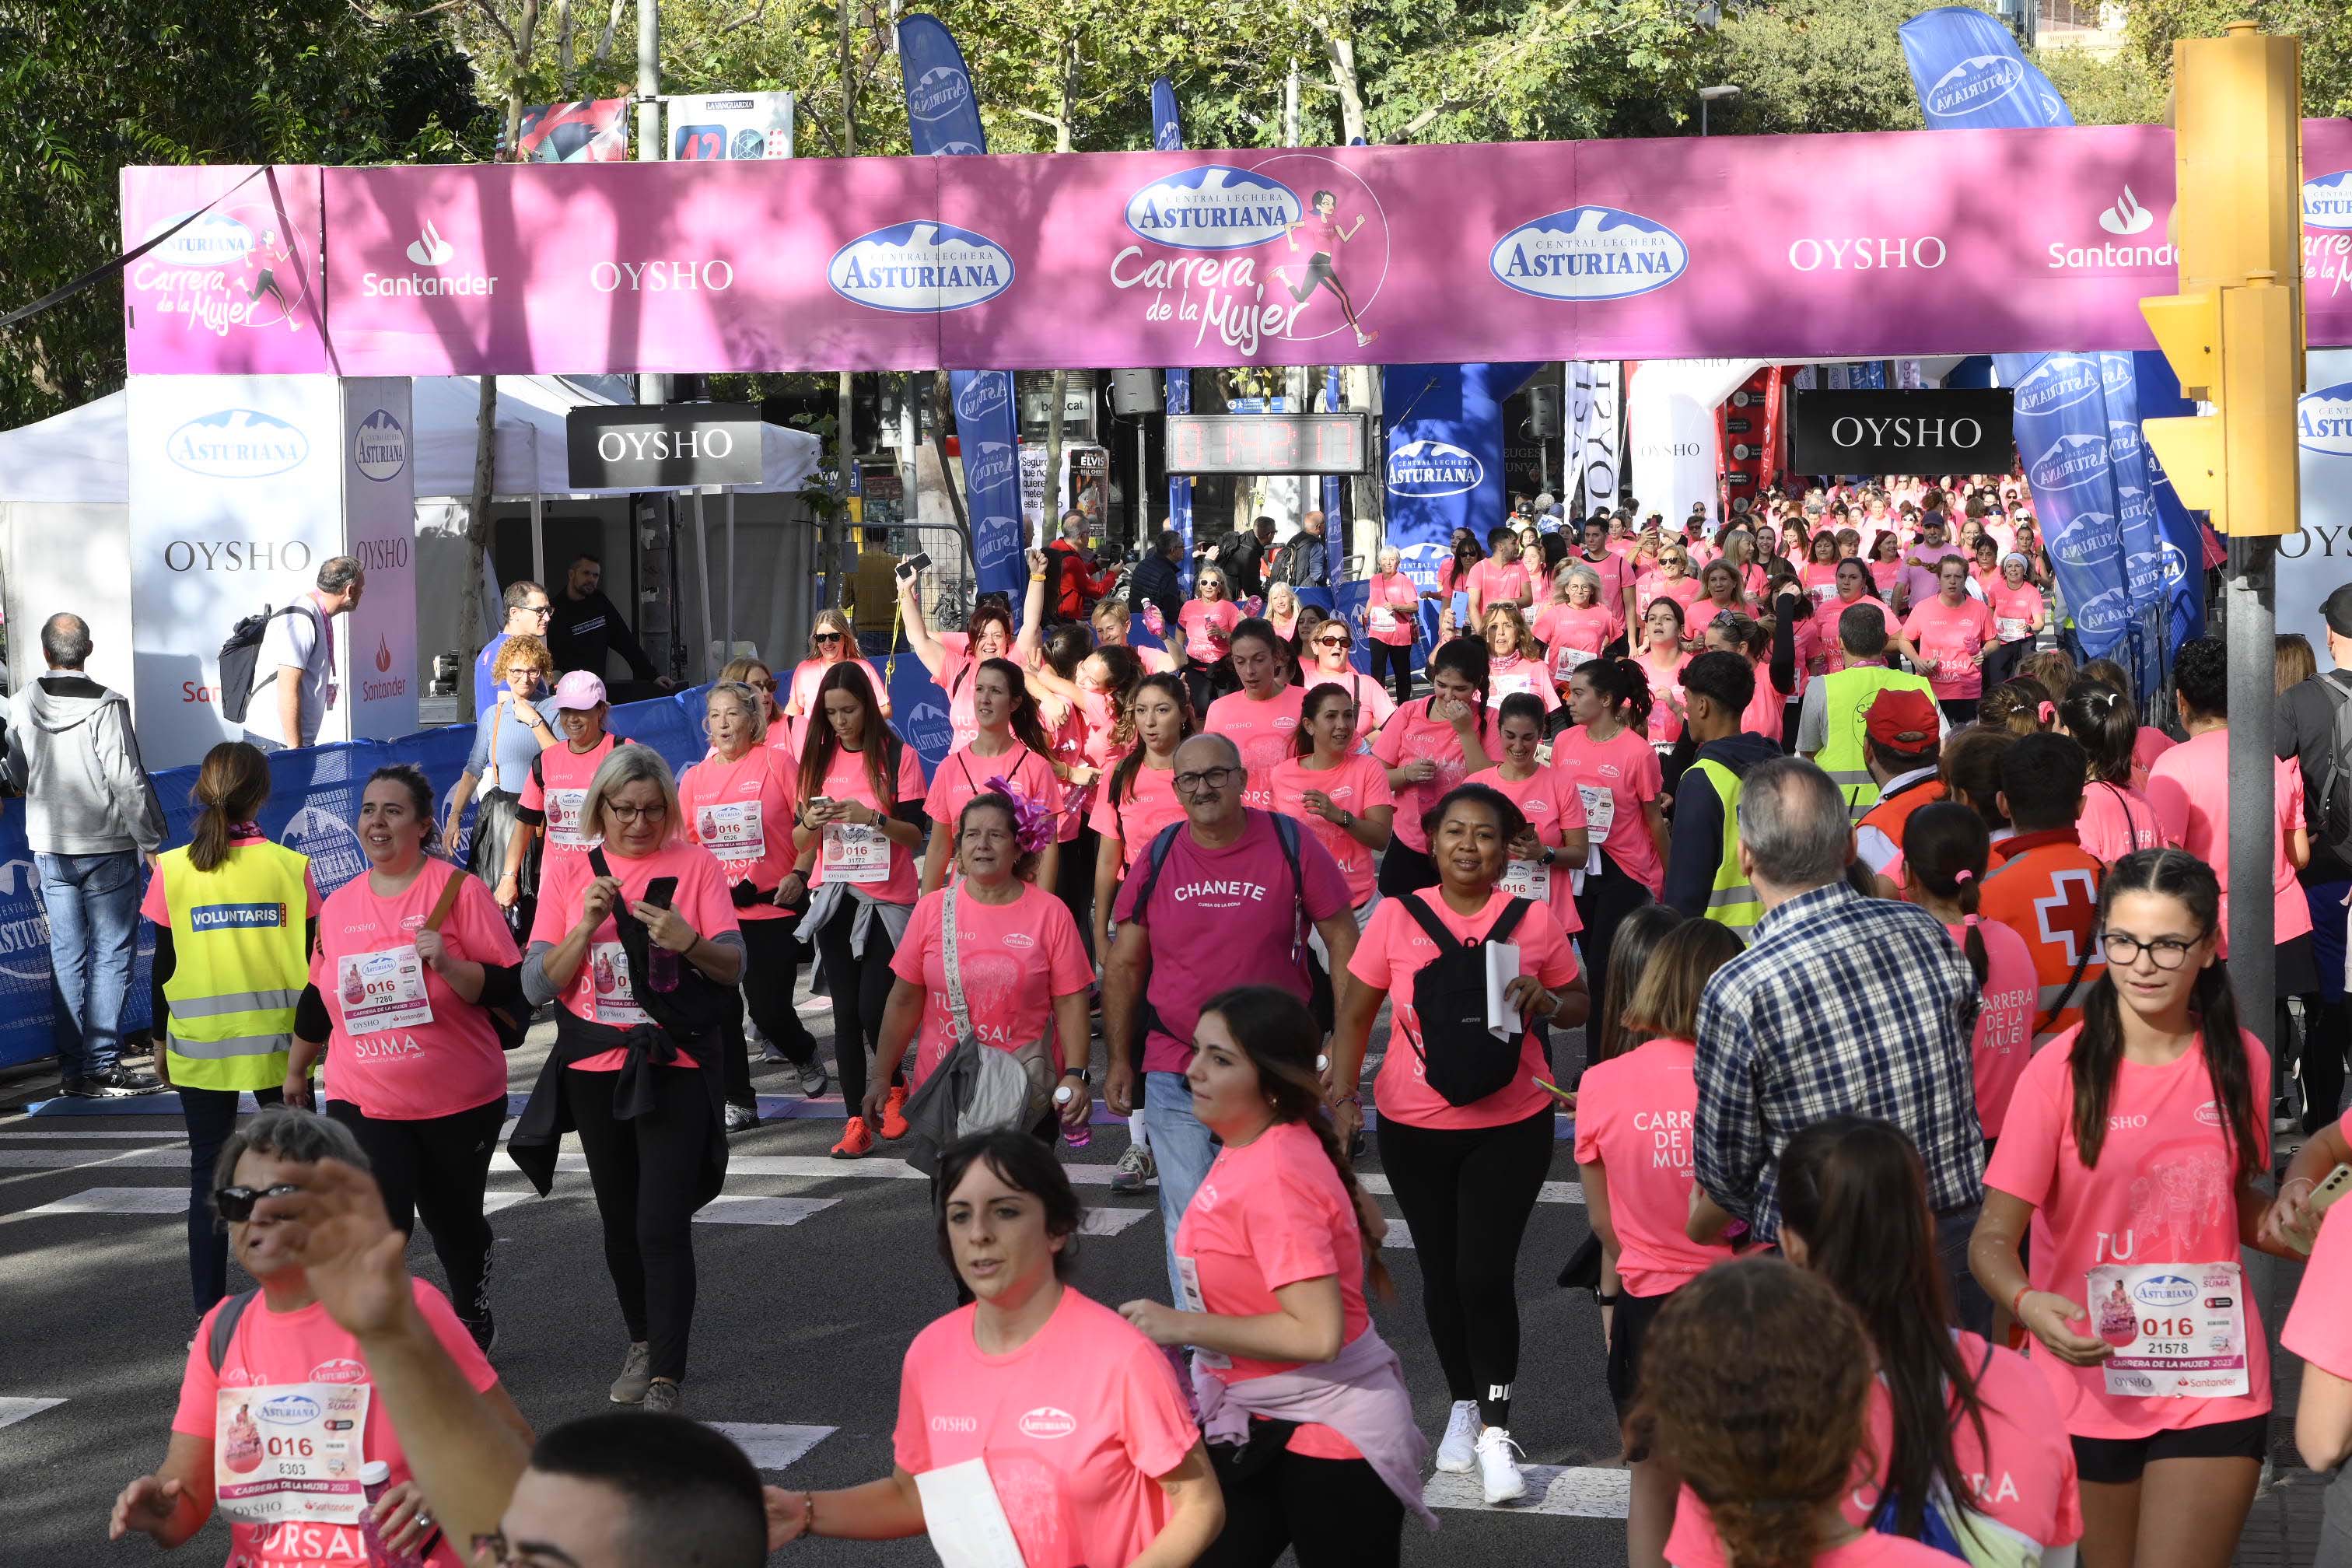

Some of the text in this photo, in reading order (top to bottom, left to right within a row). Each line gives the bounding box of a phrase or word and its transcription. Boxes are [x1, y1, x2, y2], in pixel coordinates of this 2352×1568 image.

[1165, 193, 1283, 204] CENTRAL LECHERA
[1138, 198, 1288, 229] ASTURIANA
[159, 236, 246, 251] STURIANA
[1536, 236, 1666, 249] CENTRAL LECHERA
[870, 250, 994, 261] CENTRAL LECHERA
[1505, 243, 1672, 278] ASTURIANA
[1789, 236, 1947, 271] OYSHO
[842, 256, 999, 290] ASTURIANA
[1110, 246, 1255, 289] Carrera
[134, 262, 225, 291] Carrera
[590, 259, 733, 292] OYSHO
[362, 272, 499, 297] Santander
[158, 292, 174, 312] de
[1146, 289, 1198, 321] de la
[187, 289, 261, 336] Mujer
[1195, 285, 1310, 356] Mujer
[1041, 400, 1083, 411] bc.cat
[1831, 417, 1983, 448] OYSHO
[178, 436, 299, 460] ASTURIANA
[358, 436, 403, 464] ASTURIANA
[597, 429, 733, 462] OYSHO
[1080, 457, 1104, 466] ELVIS
[1388, 464, 1476, 485] ASTURIANA
[1024, 499, 1038, 508] este
[2276, 525, 2352, 558] OY
[164, 541, 311, 571] OYSHO
[355, 537, 408, 570] OYSHO
[1932, 649, 1942, 658] TU
[1932, 671, 1959, 680] SUMA
[363, 677, 406, 702] Santander
[1226, 722, 1252, 730] OYSHO
[1405, 733, 1435, 743] OYSHO
[719, 824, 740, 834] 016
[846, 846, 868, 855] 016
[1174, 880, 1266, 901] CHANETE
[1503, 884, 1526, 893] 016
[192, 909, 278, 926] VOLUNTARIS
[345, 922, 375, 933] OYSHO
[364, 962, 394, 974] ASTURIANA
[366, 980, 395, 995] 016
[374, 996, 393, 1004] 7280
[353, 1007, 376, 1017] CARRERA
[399, 1013, 425, 1021] Santander
[1986, 1008, 2023, 1031] DE LA
[353, 1020, 380, 1030] OYSHO
[355, 1034, 421, 1058] SUMA
[1633, 1111, 1692, 1131] CARR
[1654, 1130, 1682, 1149] DE
[2095, 1229, 2133, 1262] TU
[2203, 1279, 2231, 1288] SUMA
[2139, 1287, 2193, 1299] ASTURIANA
[2142, 1318, 2193, 1336] 016
[2148, 1342, 2189, 1354] 21578
[2112, 1360, 2151, 1368] CARRERA
[315, 1369, 362, 1382] ASTURIANA
[2114, 1376, 2152, 1388] OYSHO
[2189, 1377, 2237, 1388] Santander
[261, 1406, 314, 1417] ASTURIANA
[327, 1402, 356, 1410] SUMA
[931, 1416, 977, 1432] OYSHO
[268, 1437, 313, 1456] 016
[279, 1463, 306, 1475] 8303
[235, 1482, 278, 1496] CARRERA
[303, 1482, 329, 1491] MUJER
[331, 1483, 349, 1492] 2023
[233, 1501, 282, 1517] OYSHO
